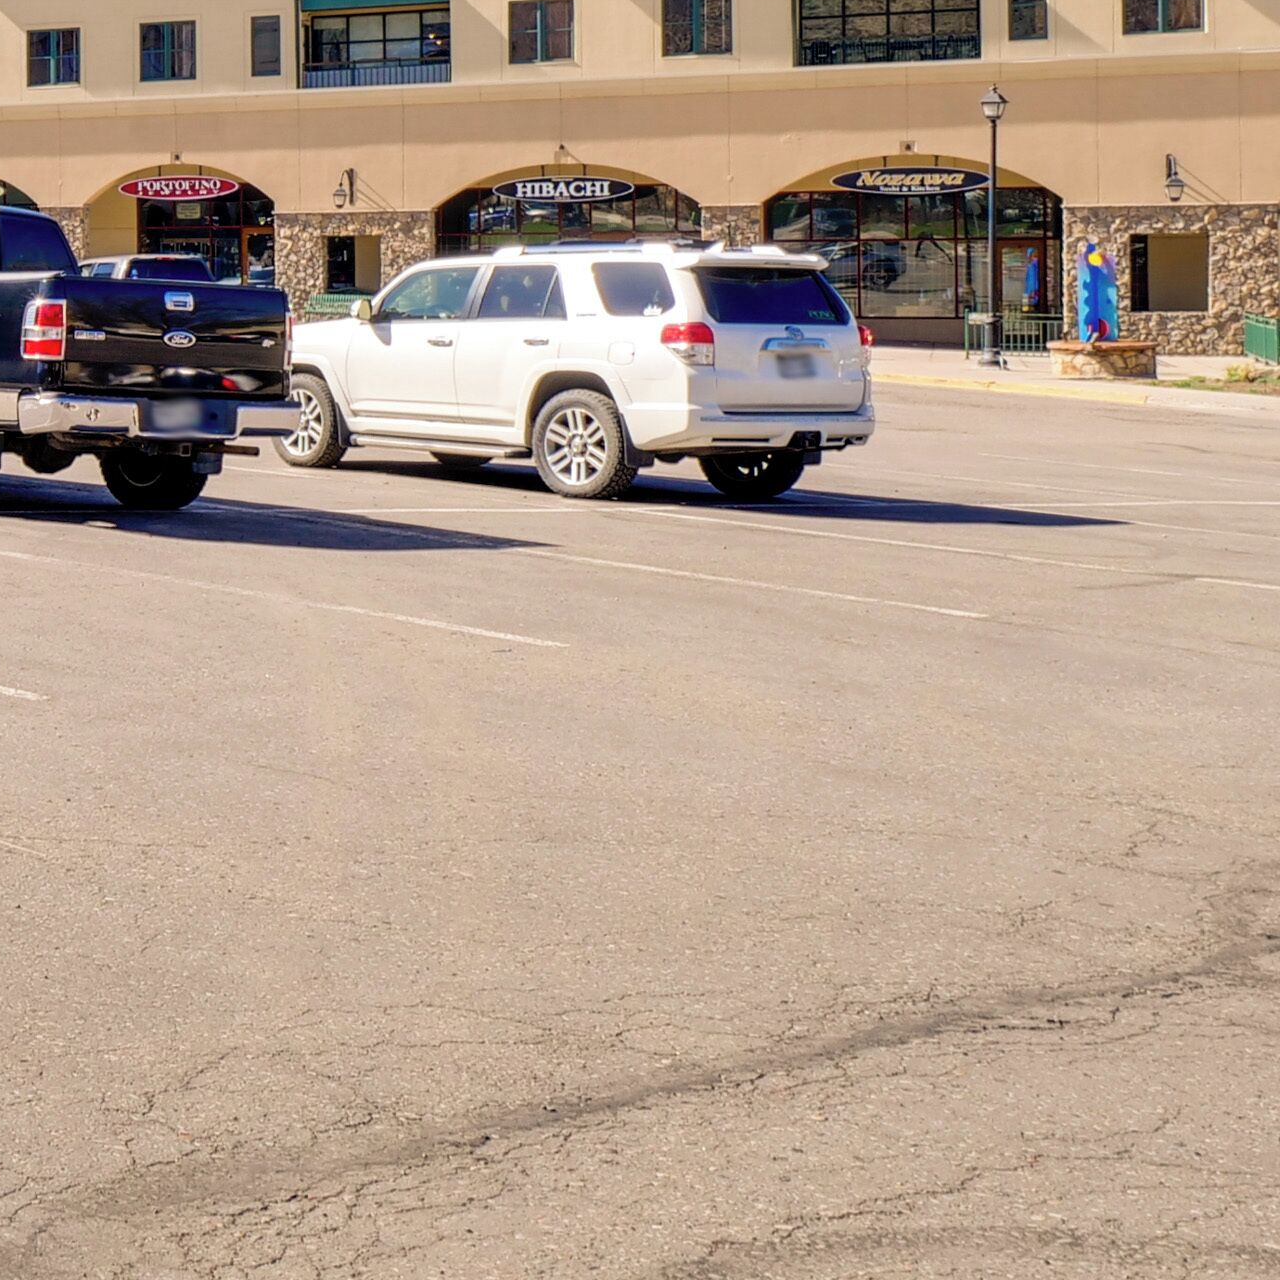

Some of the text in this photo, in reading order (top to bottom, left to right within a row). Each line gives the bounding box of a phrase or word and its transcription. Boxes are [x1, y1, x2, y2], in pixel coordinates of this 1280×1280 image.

[138, 179, 220, 193] PORTOFINO
[856, 171, 965, 187] Nozawa
[515, 181, 611, 198] HIBACHI
